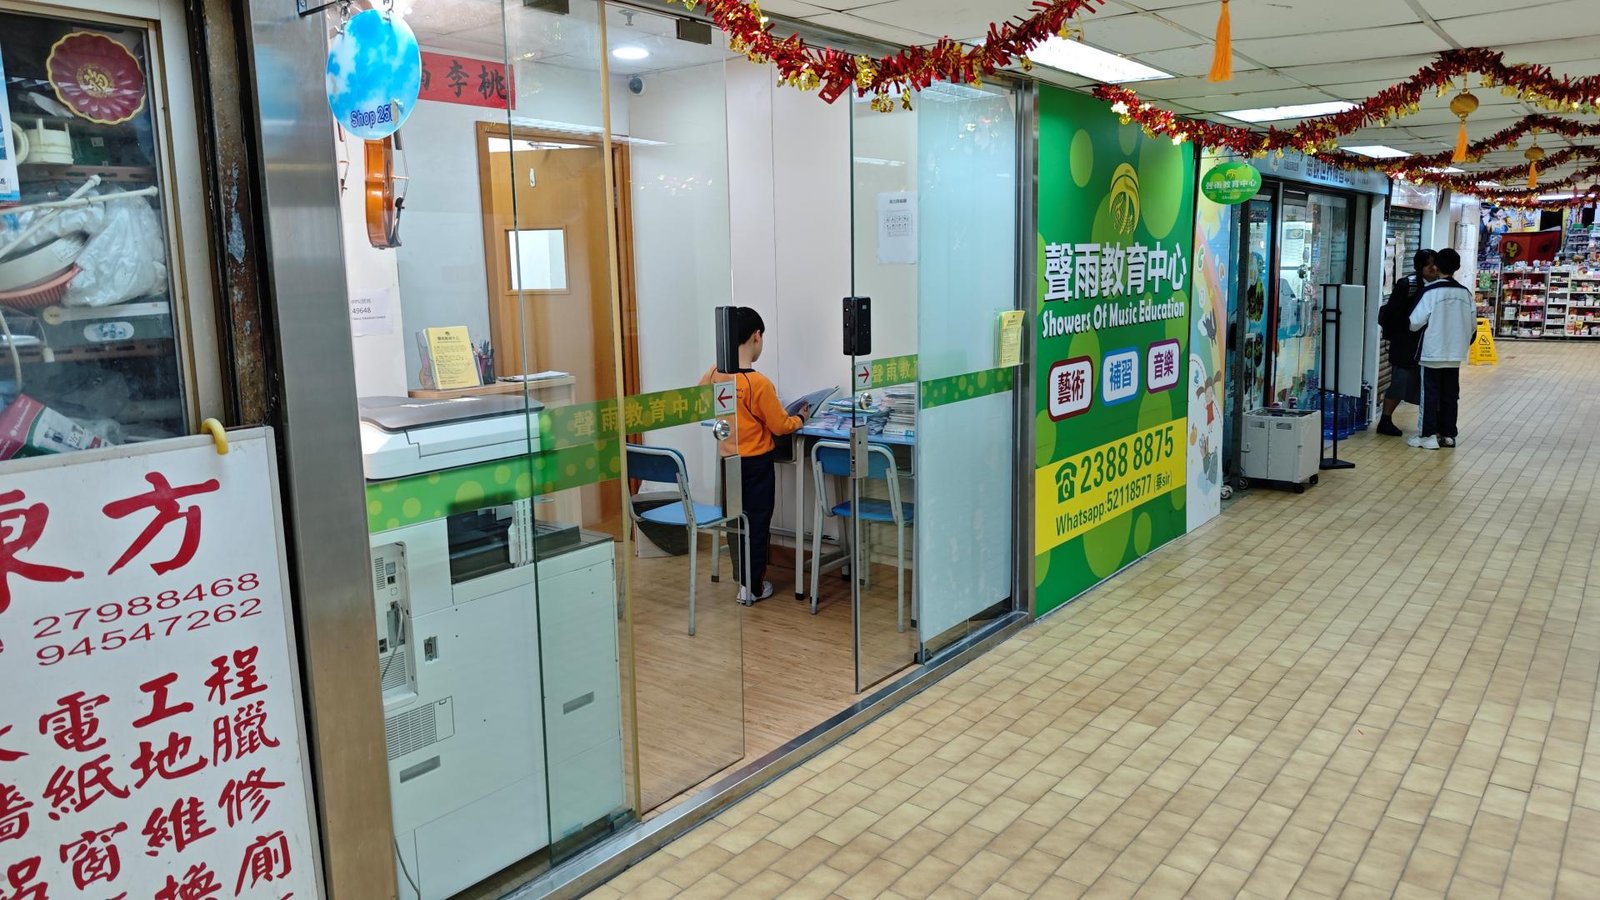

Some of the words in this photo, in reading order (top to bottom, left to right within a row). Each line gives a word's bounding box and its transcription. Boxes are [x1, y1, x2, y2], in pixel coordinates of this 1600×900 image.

[351, 109, 376, 128] Shop
[377, 103, 393, 123] 25
[1044, 241, 1187, 302] 聲雨教育中心
[1042, 309, 1091, 338] Showers
[1093, 302, 1108, 330] Of
[1109, 302, 1137, 328] Music
[1139, 297, 1185, 321] Education
[872, 360, 918, 383] 聲雨教
[1109, 358, 1133, 391] 補習
[1153, 349, 1174, 380] 音樂
[1057, 369, 1085, 405] 藝術
[574, 394, 711, 437] 聲雨教育中心
[1080, 441, 1128, 494] 2388
[1132, 425, 1174, 471] 8875
[33, 573, 260, 639] 27988468
[36, 598, 262, 666] 94547262
